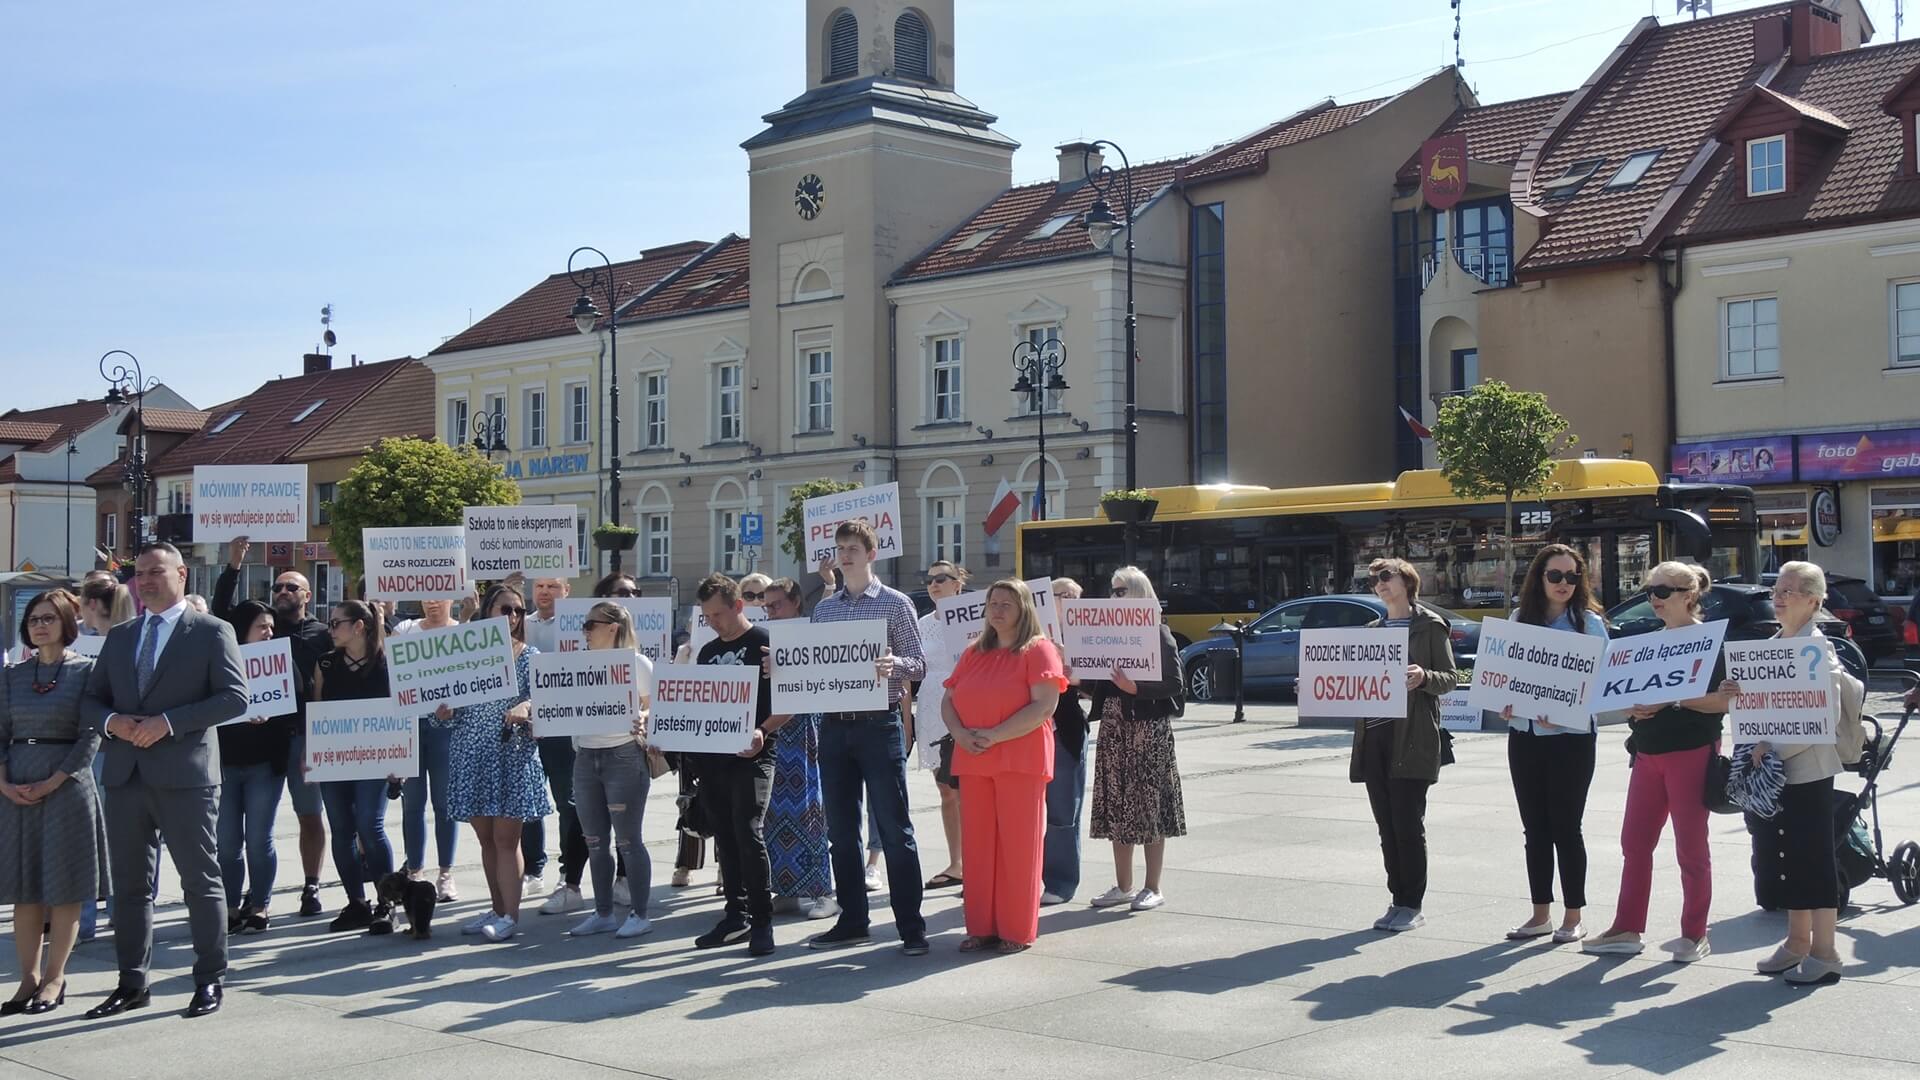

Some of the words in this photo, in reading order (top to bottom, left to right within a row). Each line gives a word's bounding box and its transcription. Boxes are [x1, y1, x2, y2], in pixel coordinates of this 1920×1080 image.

[1817, 445, 1857, 458] foto
[528, 454, 588, 476] NAREW
[199, 480, 248, 498] MÓWIMY
[251, 482, 301, 500] PRAWDĘ
[808, 505, 827, 518] NIE
[830, 492, 893, 514] JESTEŚMY
[200, 511, 209, 528] wy
[211, 509, 222, 528] się
[223, 508, 264, 528] wycofujecie
[265, 511, 275, 527] po
[276, 508, 295, 524] cichu
[469, 516, 496, 531] Szkoła
[497, 517, 506, 530] to
[507, 516, 520, 530] nie
[521, 515, 572, 532] eksperyment
[746, 516, 758, 536] P
[811, 511, 894, 541] PEJĄ
[1520, 510, 1551, 525] 225
[369, 536, 401, 551] MIASTO
[401, 536, 413, 550] TO
[414, 535, 427, 550] NIE
[428, 535, 464, 550] FOLWARK
[480, 538, 501, 550] dość
[502, 537, 563, 550] kombinowania
[382, 560, 406, 568] CZAS
[408, 556, 456, 568] ROZLICZEŃ
[471, 556, 520, 571] kosztem
[524, 555, 564, 569] DZIECI
[378, 574, 456, 593] NADCHODZI
[1066, 607, 1155, 627] CHRZANOWSKI
[391, 625, 505, 667] EDUKACJA
[1081, 635, 1094, 646] NIE
[1095, 635, 1128, 646] CHOWAJ
[1129, 635, 1142, 648] SIĘ
[1608, 648, 1633, 668] NIE
[1634, 646, 1655, 664] dla
[1656, 636, 1713, 662] łączenia
[776, 646, 810, 667] GŁOS
[812, 639, 881, 665] RODZICÓW
[1070, 654, 1116, 669] MIESZKAŃCY
[1117, 657, 1151, 672] CZEKAJĄ
[1304, 644, 1341, 662] RODZICE
[1342, 644, 1356, 662] NIE
[1357, 644, 1387, 666] DADZĄ
[1387, 643, 1402, 666] SIĘ
[1484, 636, 1507, 657] TAK
[1507, 641, 1525, 661] dla
[1526, 645, 1560, 668] dobra
[1561, 651, 1596, 675] dzieci
[1729, 651, 1747, 663] NIE
[1748, 648, 1794, 661] CHCECIE
[1800, 644, 1822, 681] ?
[396, 672, 413, 683] to
[418, 655, 505, 678] inwestycja
[535, 666, 574, 689] Łomża
[576, 665, 608, 687] mówi
[610, 663, 631, 685] NIE
[1731, 661, 1796, 681] SŁUCHAĆ
[397, 688, 419, 707] NIE
[420, 683, 451, 702] koszt
[452, 679, 468, 697] do
[469, 673, 503, 695] cięcia
[657, 679, 752, 705] REFERENDUM
[777, 678, 804, 693] musi
[806, 678, 826, 694] być
[1314, 669, 1391, 701] OSZUKAĆ
[1480, 670, 1508, 689] STOP
[1508, 677, 1578, 708] dezorganizacji
[1735, 690, 1770, 710] ZROBIMY
[1771, 689, 1827, 709] REFERENDUM
[537, 704, 574, 722] cięciom
[575, 706, 584, 717] w
[585, 700, 626, 717] oświacie
[311, 716, 360, 736] MÓWIMY
[362, 715, 413, 734] PRAWDĘ
[652, 714, 702, 737] jesteśmy
[704, 716, 742, 737] gotowi
[1738, 722, 1801, 736] POSŁUCHACIE
[1802, 721, 1822, 735] URN
[312, 750, 322, 767] wy
[323, 747, 335, 766] się
[336, 745, 376, 766] wycofujecie
[377, 748, 387, 764] po
[388, 743, 408, 759] cichu
